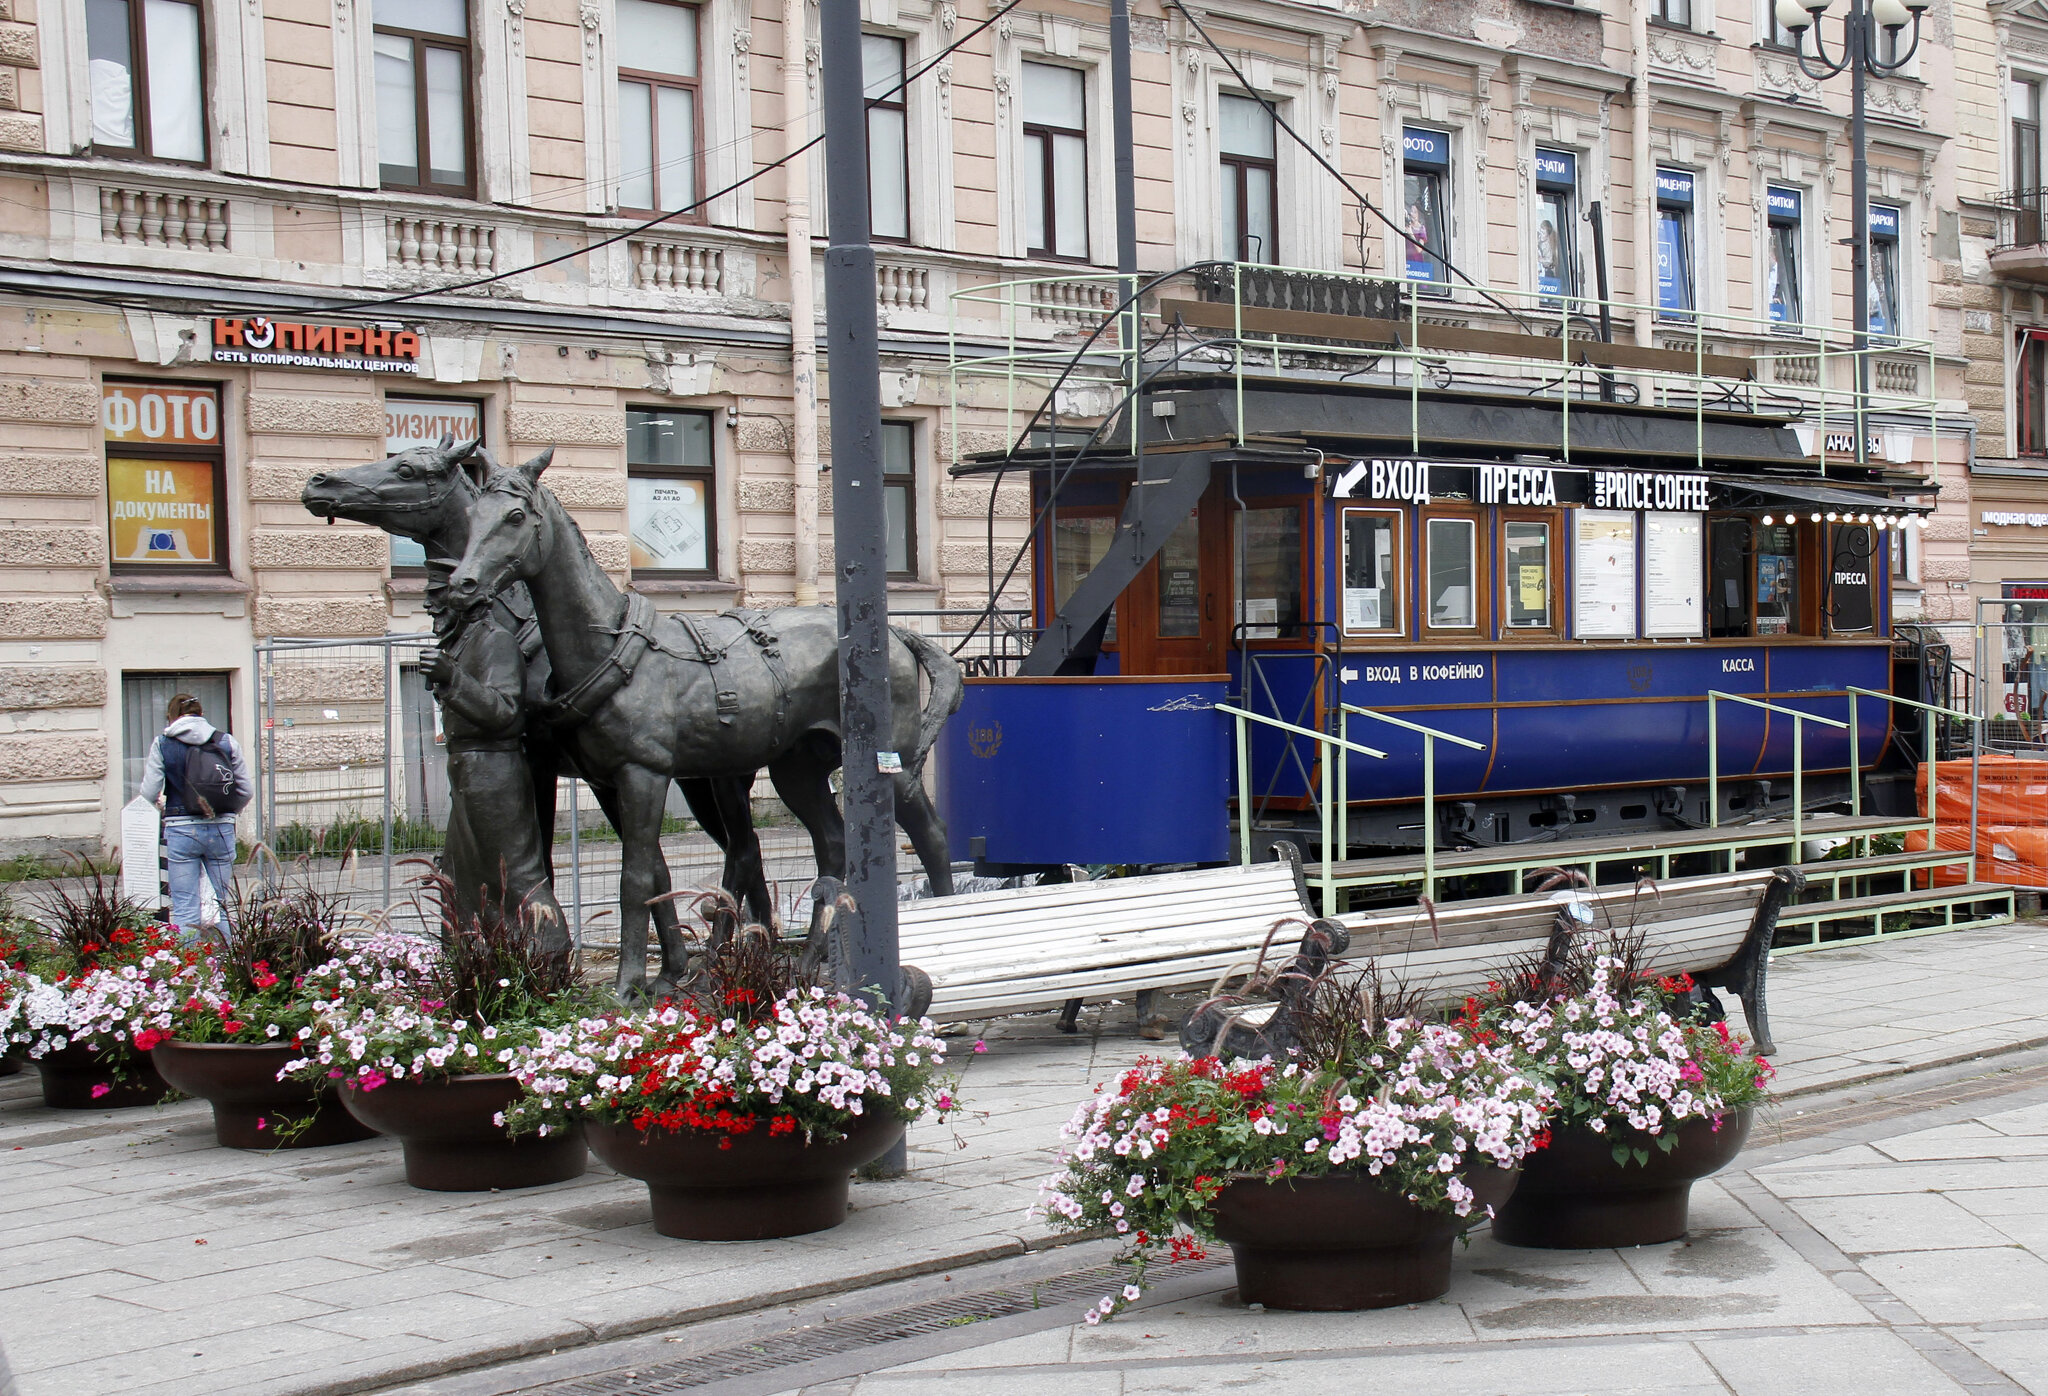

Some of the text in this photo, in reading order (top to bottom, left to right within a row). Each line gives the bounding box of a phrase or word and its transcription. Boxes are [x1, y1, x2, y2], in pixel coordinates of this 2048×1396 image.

[1403, 137, 1434, 153] ФОТО
[1535, 158, 1565, 174] ЕЧАТИ
[215, 317, 420, 357] КОПИРКА
[214, 351, 419, 373] СЕТЬ КОПИРОВАЛЬНЫХ ЦЕНТРОВ
[103, 390, 217, 440] ФОТО
[1827, 434, 1881, 454] АНАЗЫ
[145, 470, 176, 494] НА
[1371, 460, 1430, 504] ВХОД
[1480, 466, 1556, 506] ПРЕССА
[1595, 471, 1709, 511] ONE PRICE COFFEE
[113, 501, 210, 520] ДОКУМЕНТЫ
[1835, 572, 1867, 585] ПРЕССА
[1366, 661, 1484, 684] ВХОД В КОФЕЙНЮ
[1722, 658, 1754, 673] КАССА
